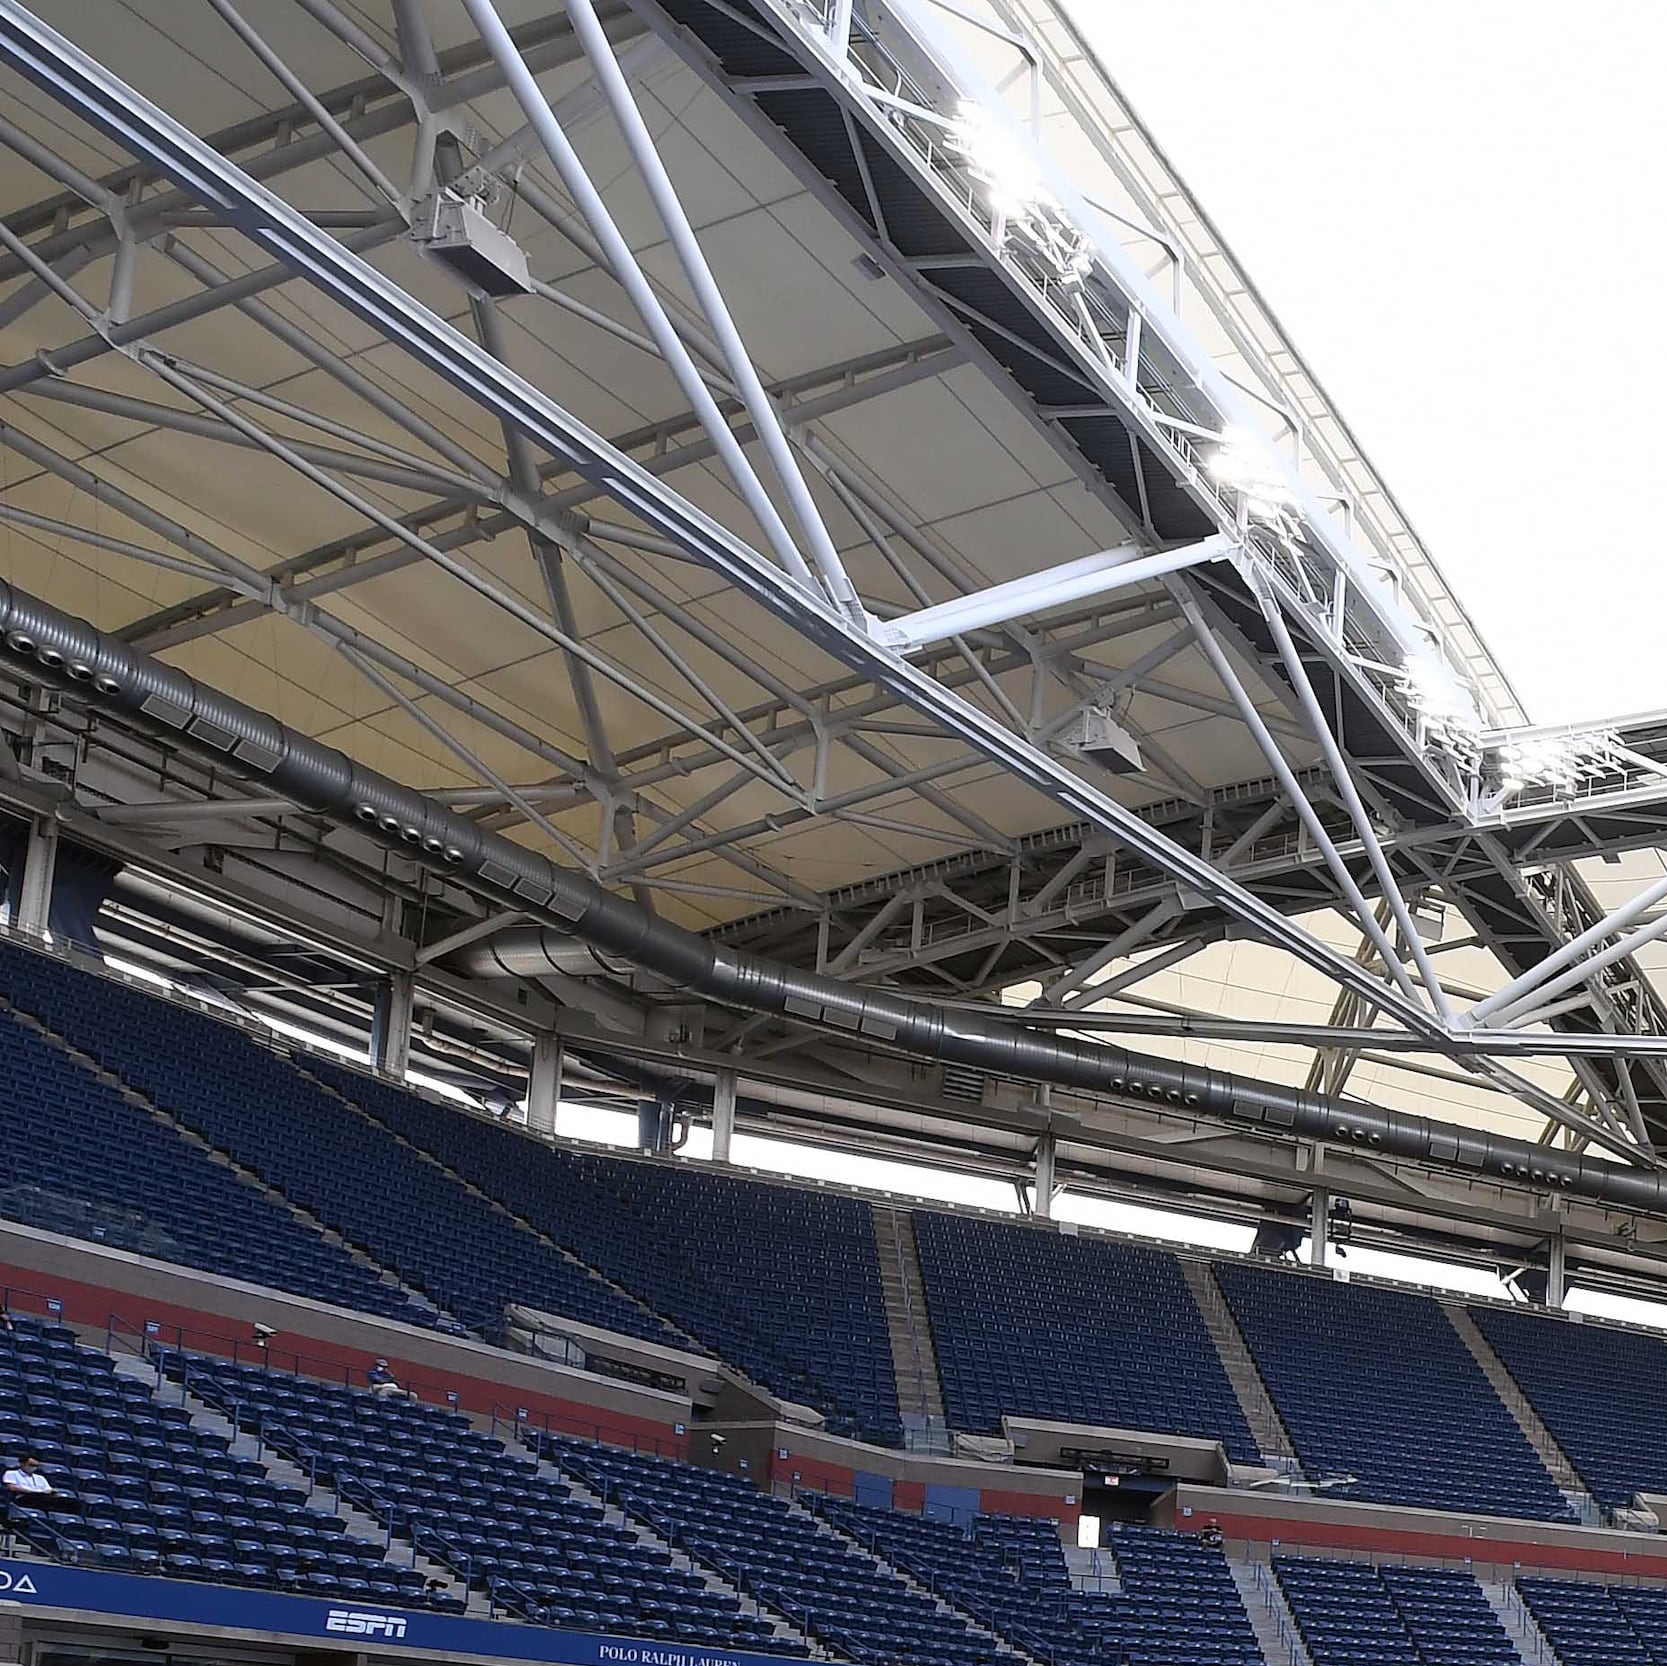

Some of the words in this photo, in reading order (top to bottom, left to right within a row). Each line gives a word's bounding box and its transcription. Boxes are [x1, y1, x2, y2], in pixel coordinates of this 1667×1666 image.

[327, 1610, 407, 1637] ESPN
[599, 1645, 638, 1662] POLO
[641, 1650, 686, 1666] RALPH
